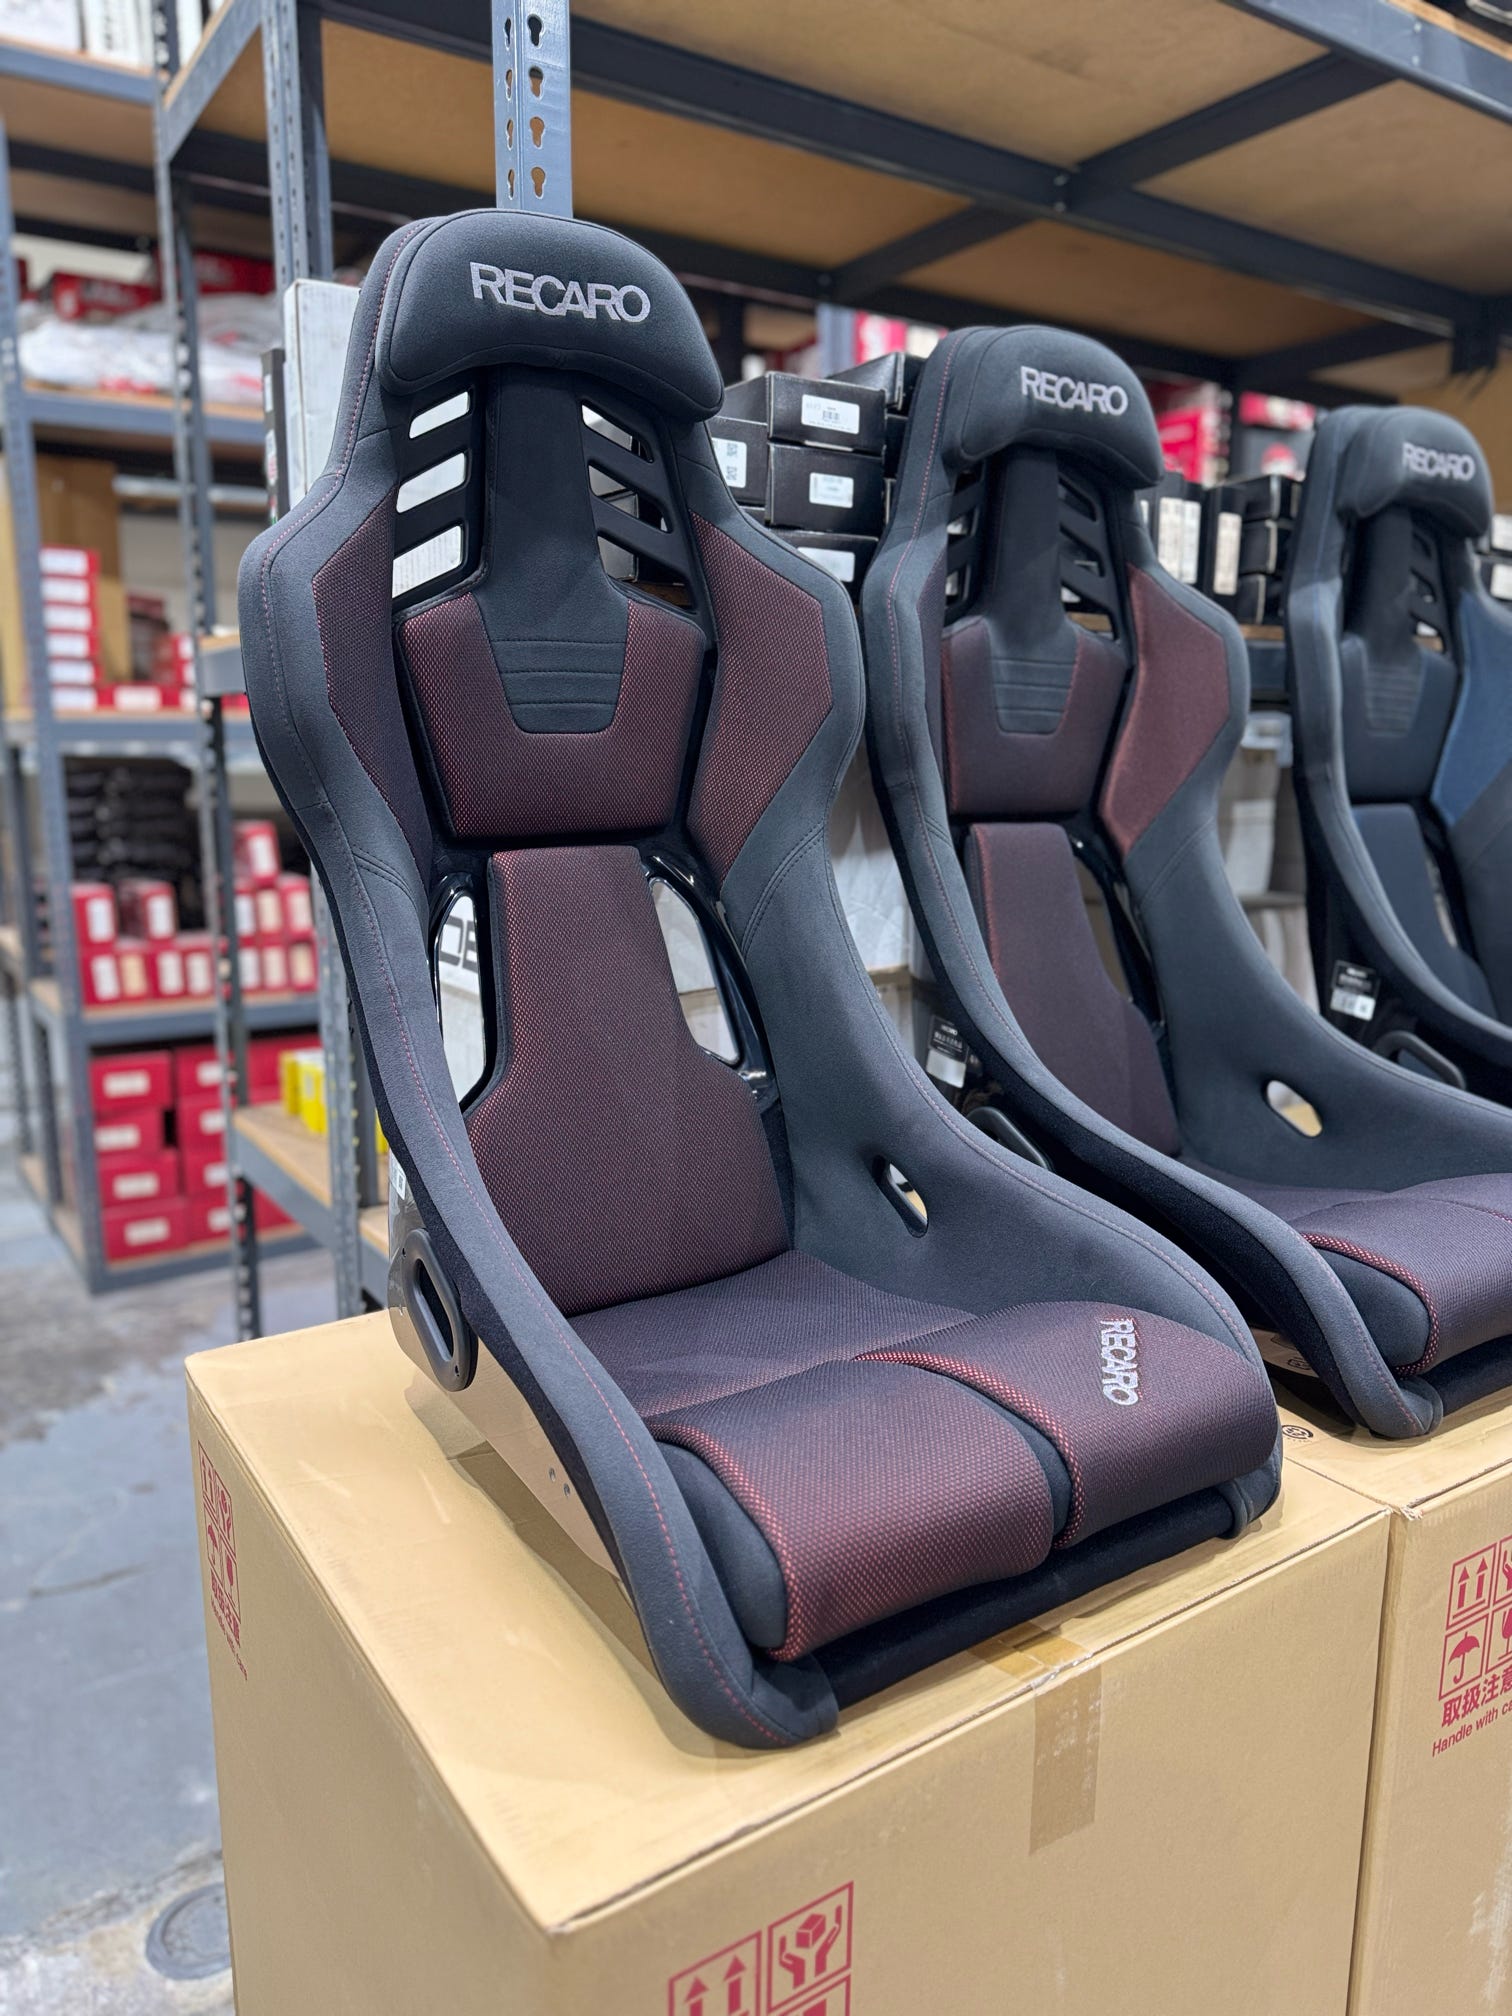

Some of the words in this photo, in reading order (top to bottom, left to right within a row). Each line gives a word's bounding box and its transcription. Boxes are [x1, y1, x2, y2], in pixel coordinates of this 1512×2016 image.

[469, 261, 651, 322] RECARO
[1020, 365, 1129, 416] RECARO
[1402, 441, 1476, 482] RECARO
[1100, 1319, 1138, 1405] RECARO
[1432, 1724, 1473, 1757] Handle
[1476, 1707, 1499, 1731] with
